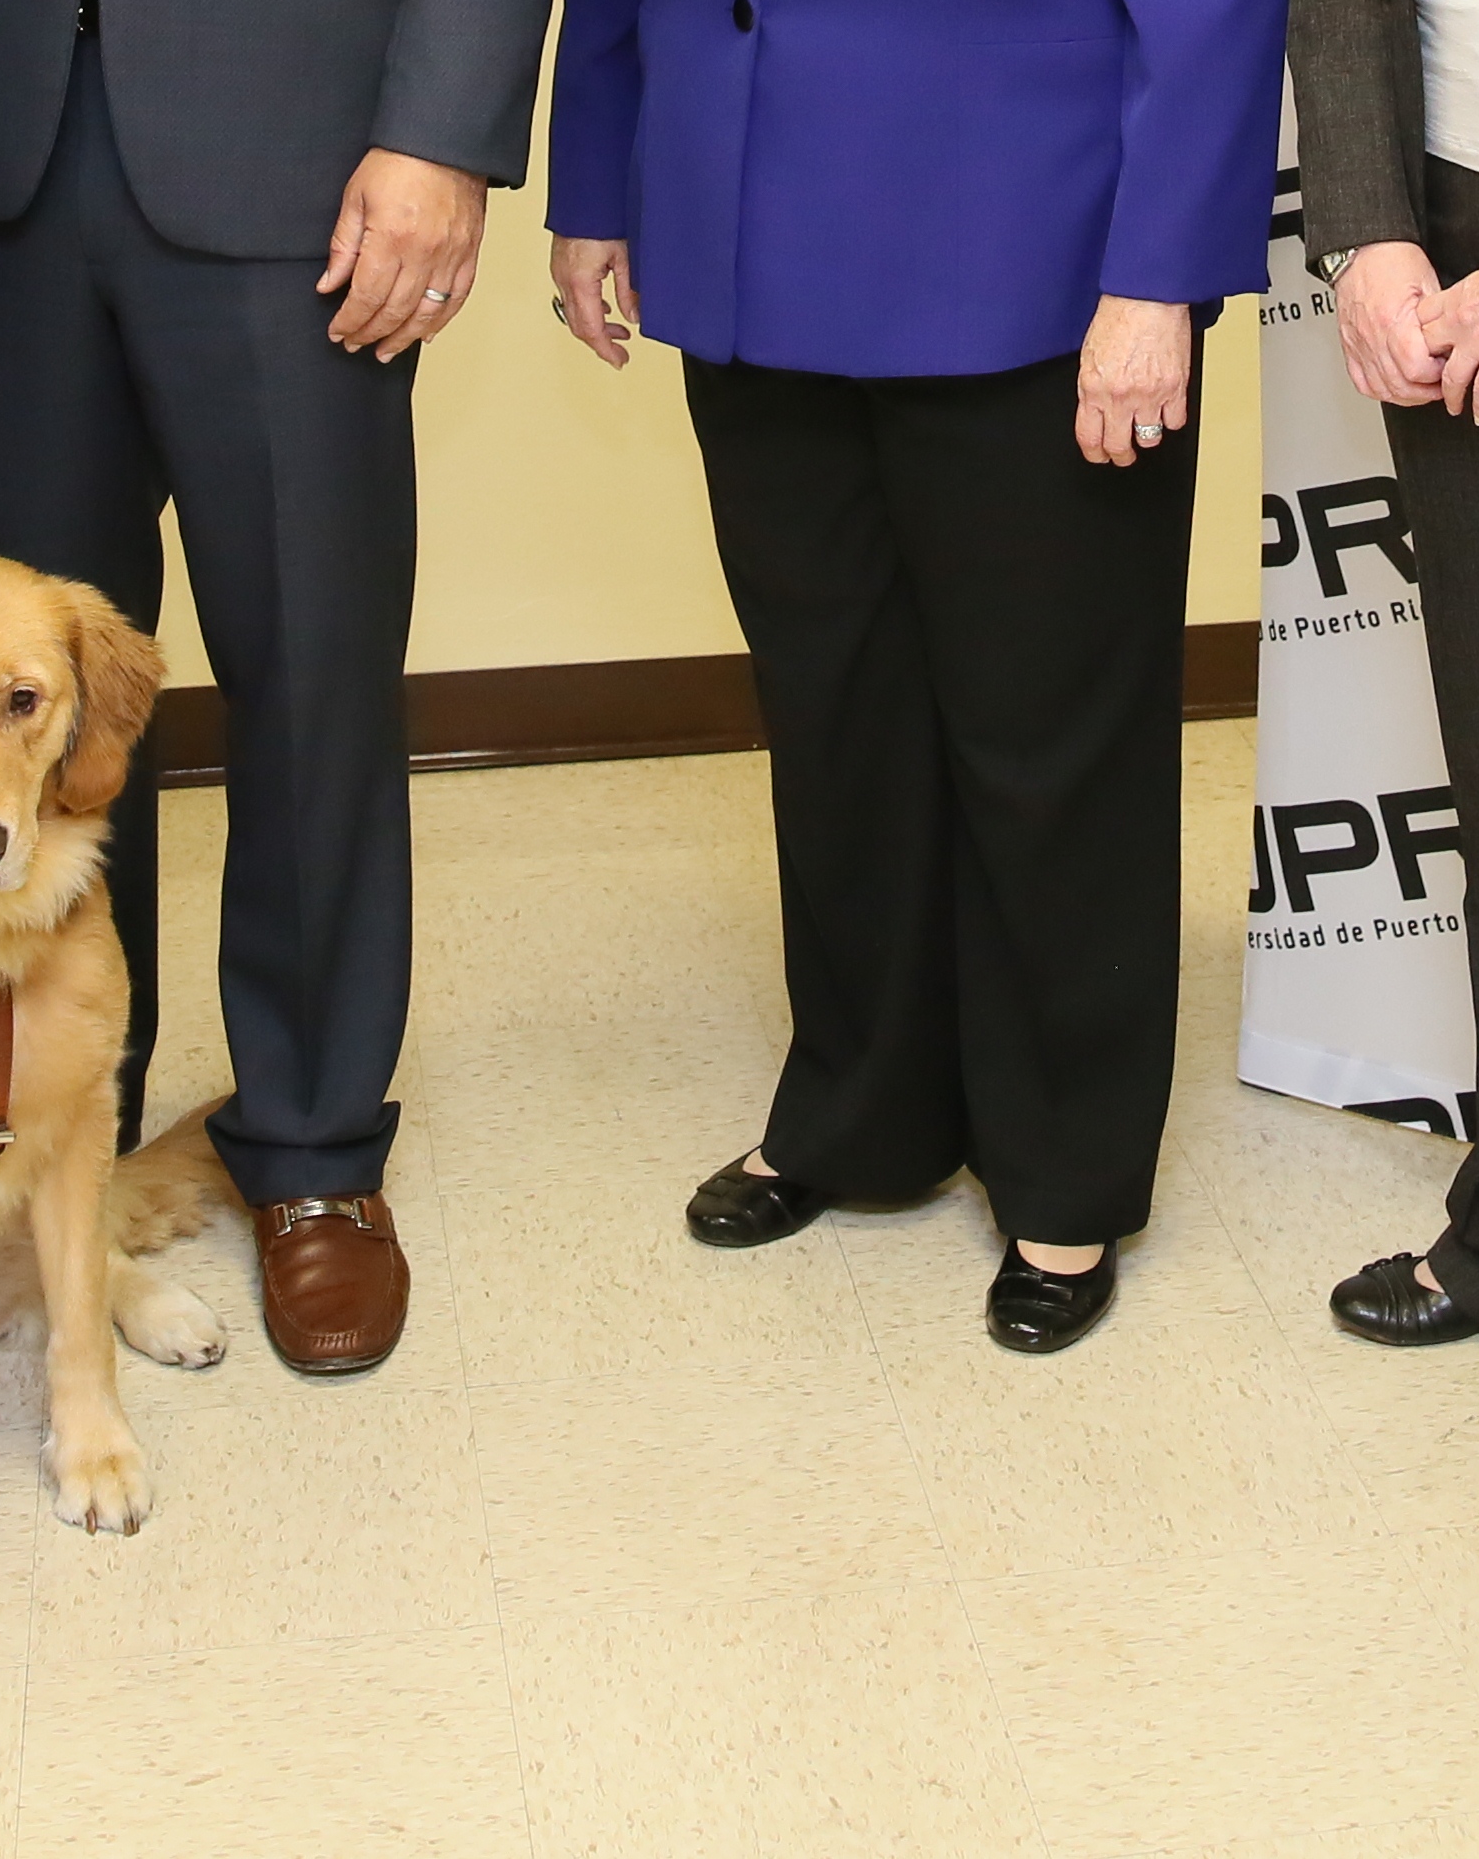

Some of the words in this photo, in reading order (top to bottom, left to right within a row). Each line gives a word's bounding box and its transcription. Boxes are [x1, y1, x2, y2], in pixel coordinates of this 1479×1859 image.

[1259, 302, 1301, 325] erto
[1268, 619, 1287, 641] de
[1295, 609, 1380, 638] Puerto
[1248, 925, 1324, 949] ersidad
[1337, 922, 1363, 944] de
[1374, 913, 1459, 940] Puerto
